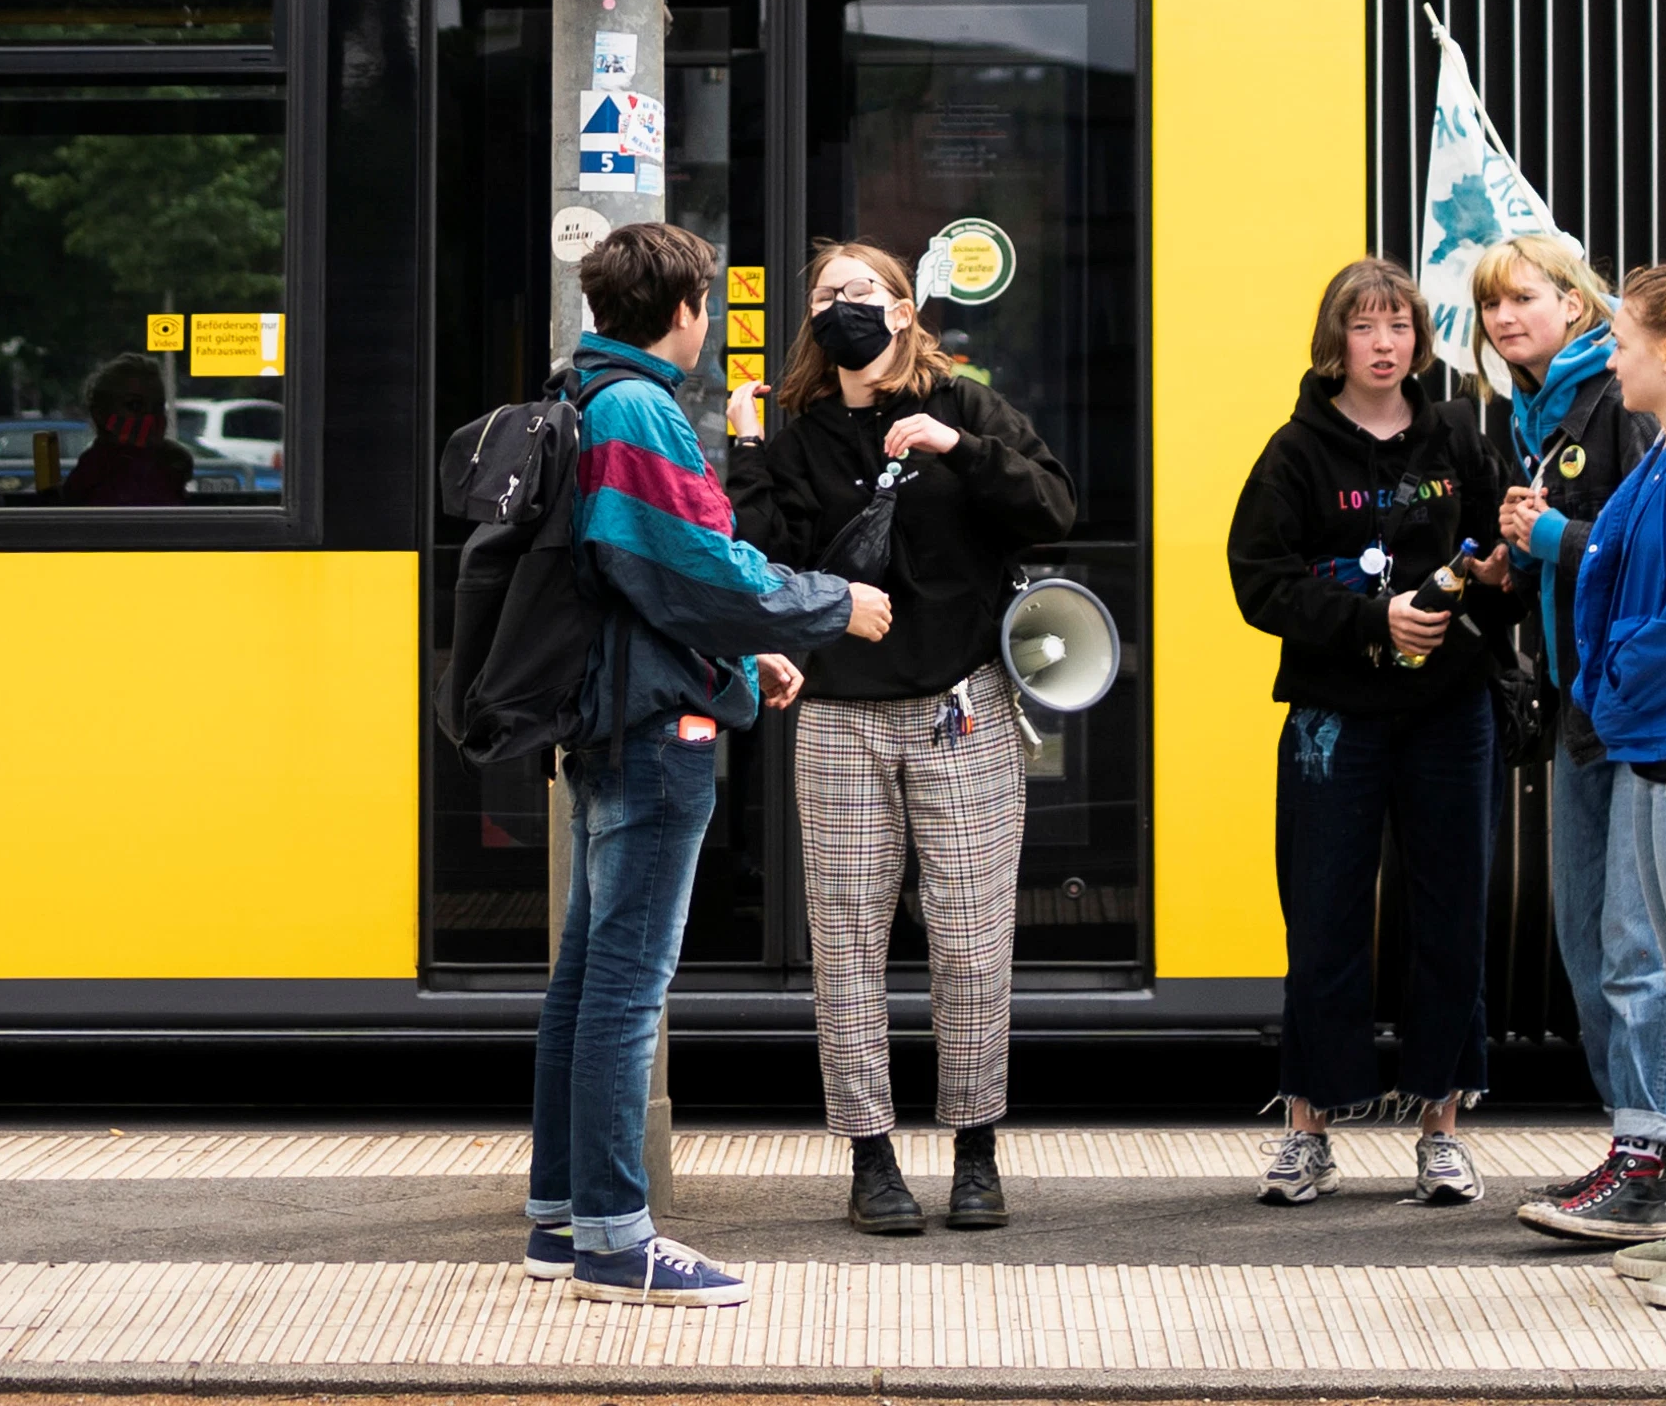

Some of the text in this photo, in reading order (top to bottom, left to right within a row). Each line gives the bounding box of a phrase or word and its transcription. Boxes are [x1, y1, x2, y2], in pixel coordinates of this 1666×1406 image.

[601, 153, 614, 173] 5
[196, 321, 278, 331] Beförderung nur
[154, 340, 179, 348] Video
[196, 334, 260, 344] mit gültigem
[196, 347, 257, 356] Fahrausweis
